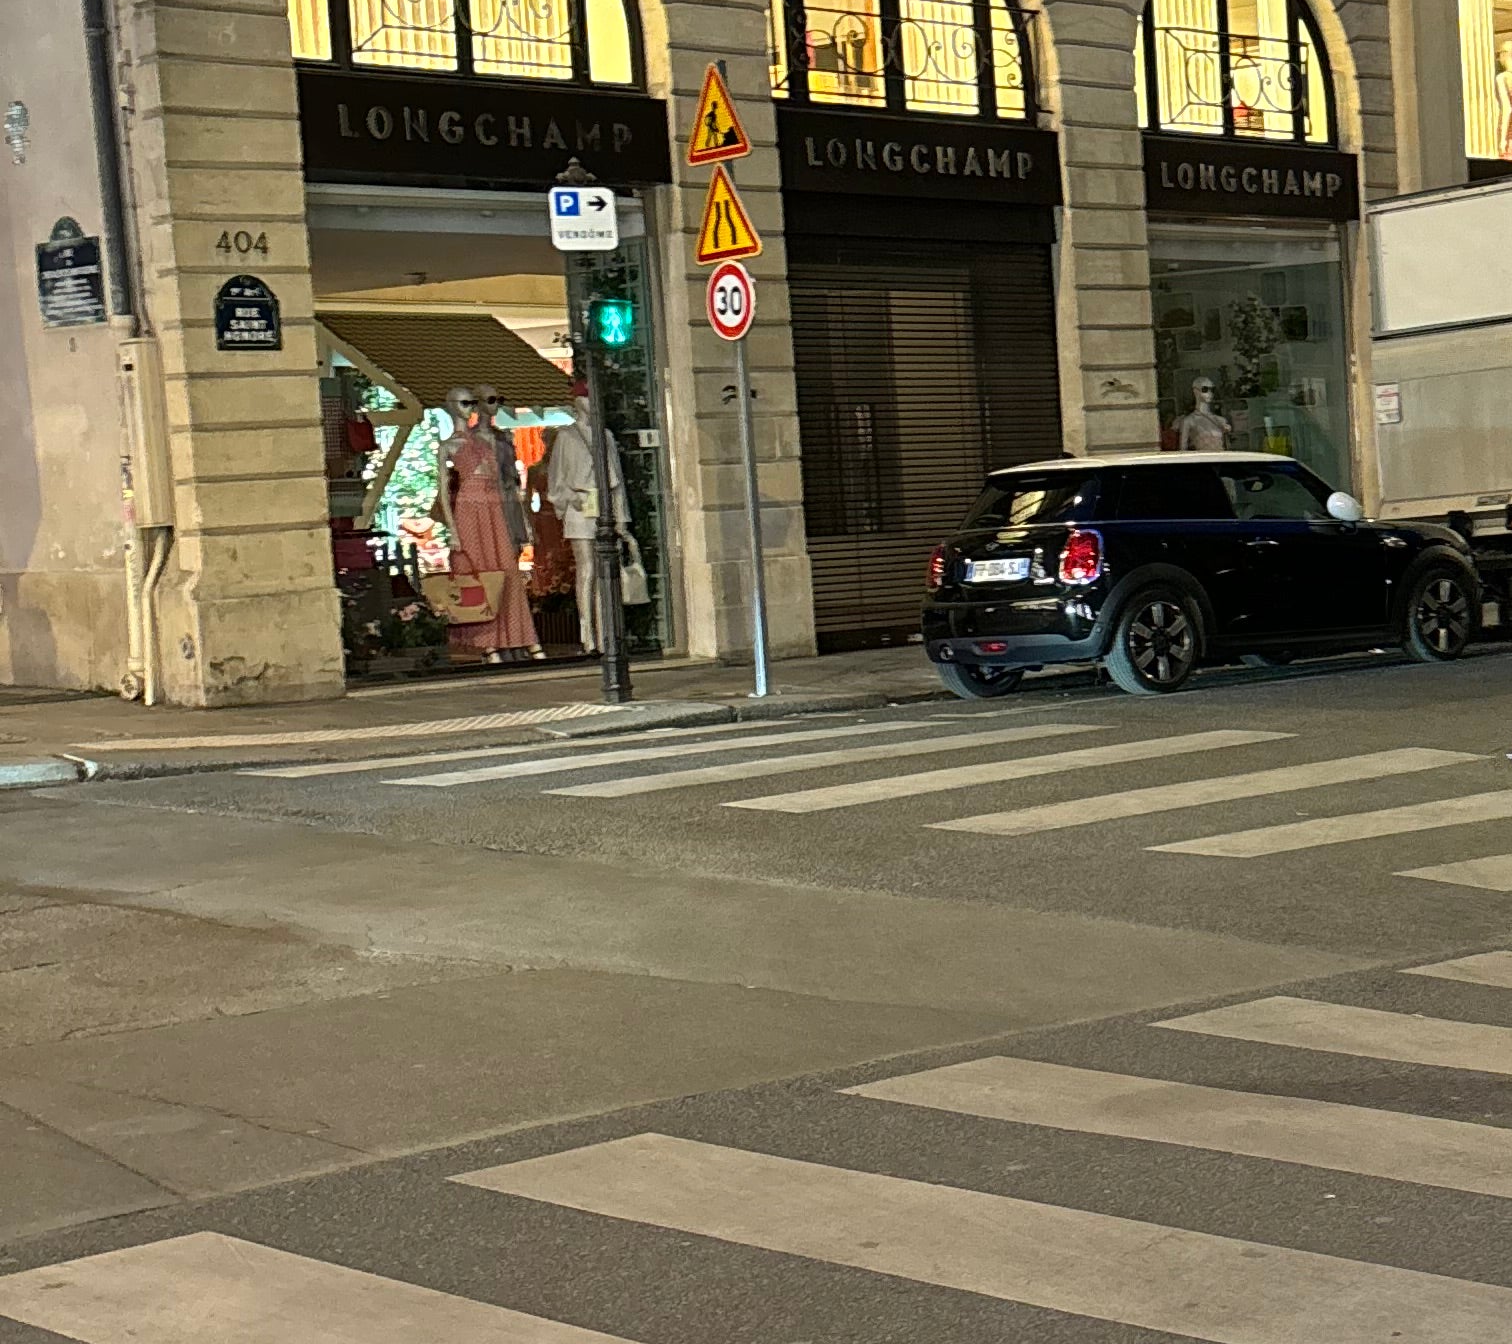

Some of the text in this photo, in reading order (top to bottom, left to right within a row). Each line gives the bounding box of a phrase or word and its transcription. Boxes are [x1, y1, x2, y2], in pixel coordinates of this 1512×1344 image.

[337, 103, 633, 153] LONGCHAMP
[805, 136, 1033, 180] LONGCHAMP
[1160, 161, 1342, 198] LONGCHAMP
[559, 195, 575, 213] P
[215, 230, 269, 254] 404
[716, 286, 742, 316] 30
